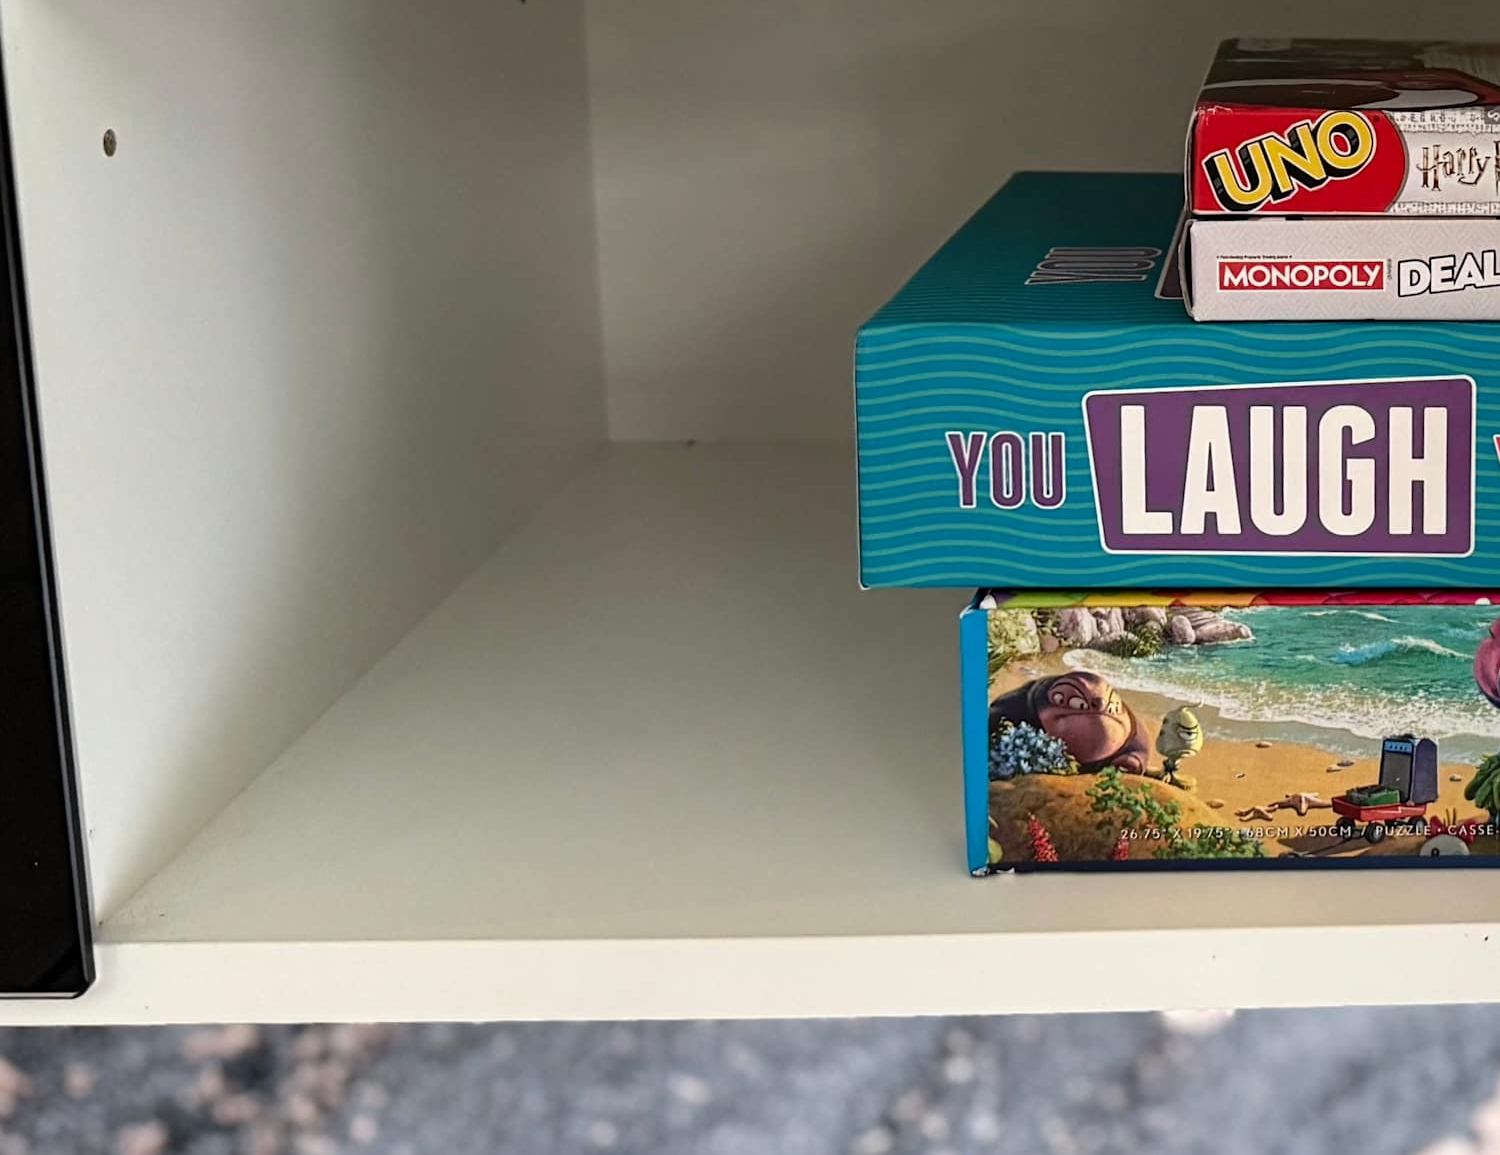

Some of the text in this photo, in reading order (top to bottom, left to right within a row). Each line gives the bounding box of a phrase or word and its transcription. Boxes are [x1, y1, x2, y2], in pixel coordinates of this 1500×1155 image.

[1202, 109, 1377, 214] UNO
[1416, 143, 1491, 192] Harry
[1222, 263, 1382, 288] MONOPOLY
[945, 431, 1067, 509] YOU
[1119, 404, 1448, 536] LAUGH
[1172, 828, 1182, 840] X
[1246, 826, 1289, 838] 68CM
[1294, 826, 1303, 837] X
[1309, 825, 1352, 838] 50CM
[1375, 824, 1432, 836] PUZZLE
